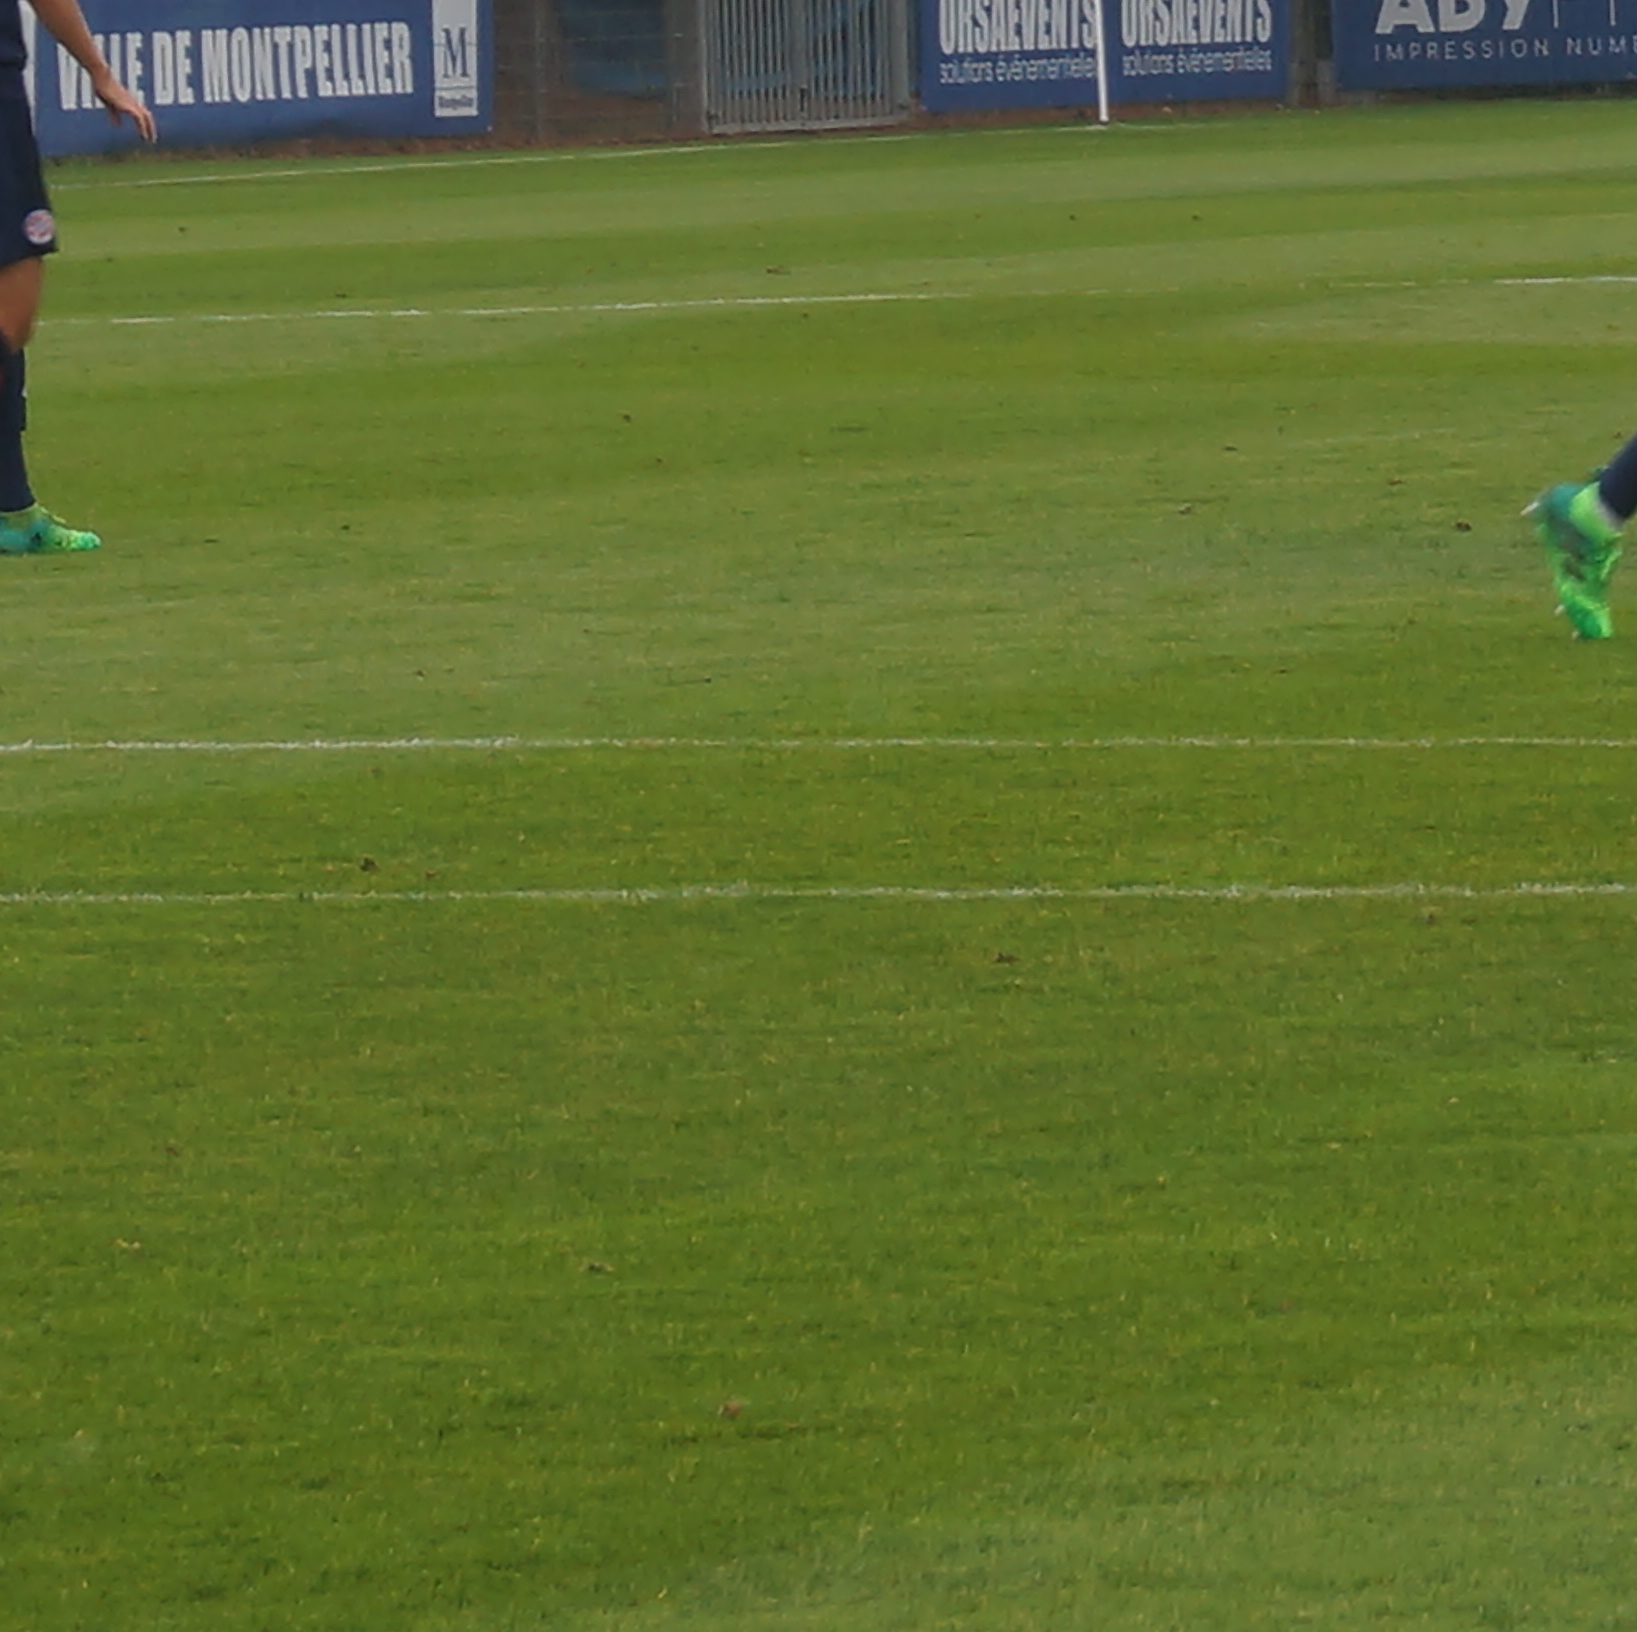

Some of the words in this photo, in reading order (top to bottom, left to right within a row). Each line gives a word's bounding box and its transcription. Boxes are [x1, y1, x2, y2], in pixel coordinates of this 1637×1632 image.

[152, 29, 195, 106] DE
[201, 21, 414, 104] MONTPELLIER
[441, 27, 470, 79] M
[1373, 38, 1549, 62] IMPRESSION
